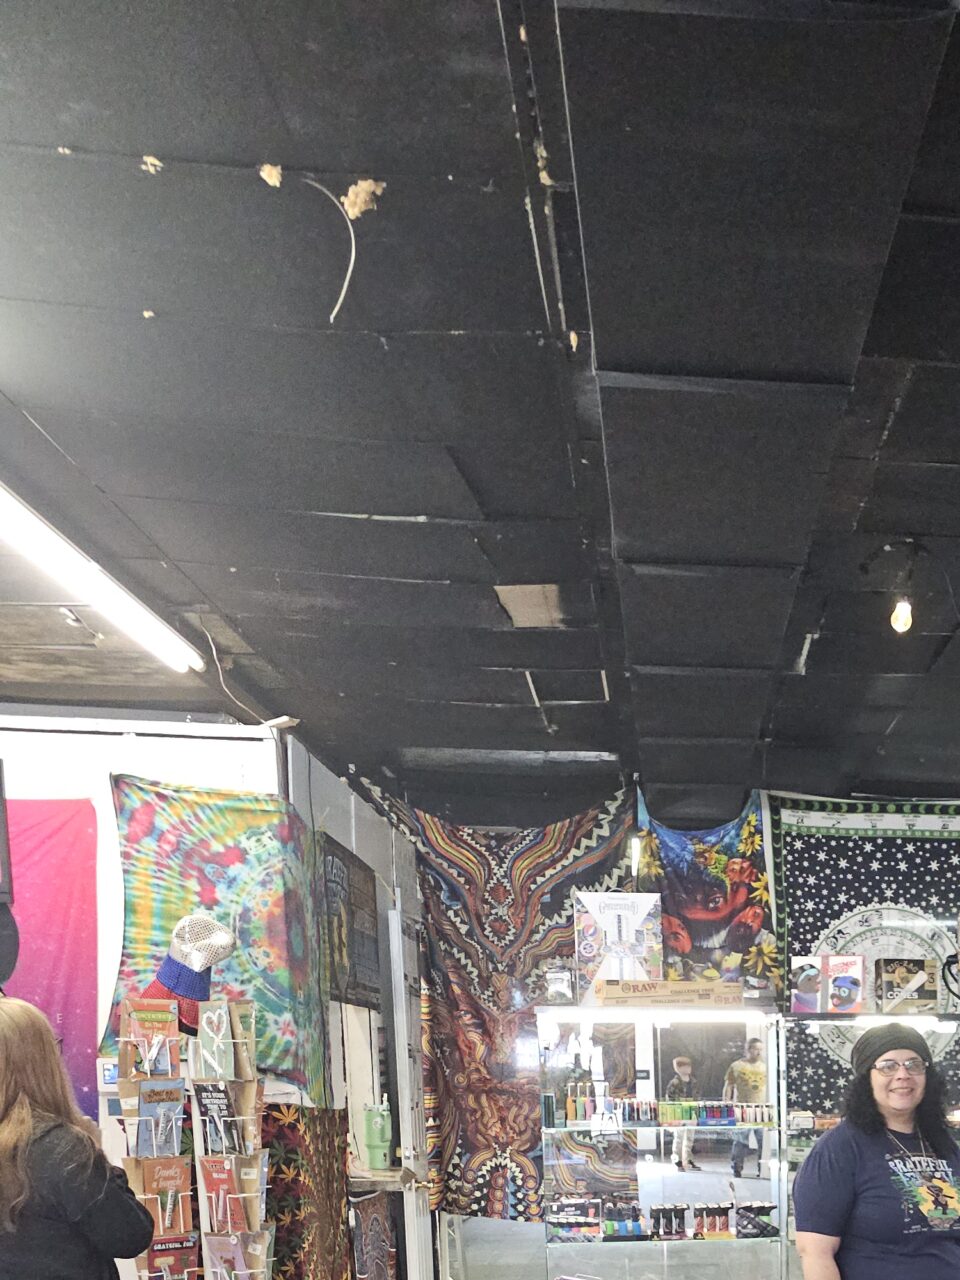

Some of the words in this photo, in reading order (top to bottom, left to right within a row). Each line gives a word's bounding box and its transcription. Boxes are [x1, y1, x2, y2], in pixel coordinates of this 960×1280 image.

[928, 973, 935, 984] 3
[631, 982, 658, 993] RAW
[887, 991, 919, 999] COES
